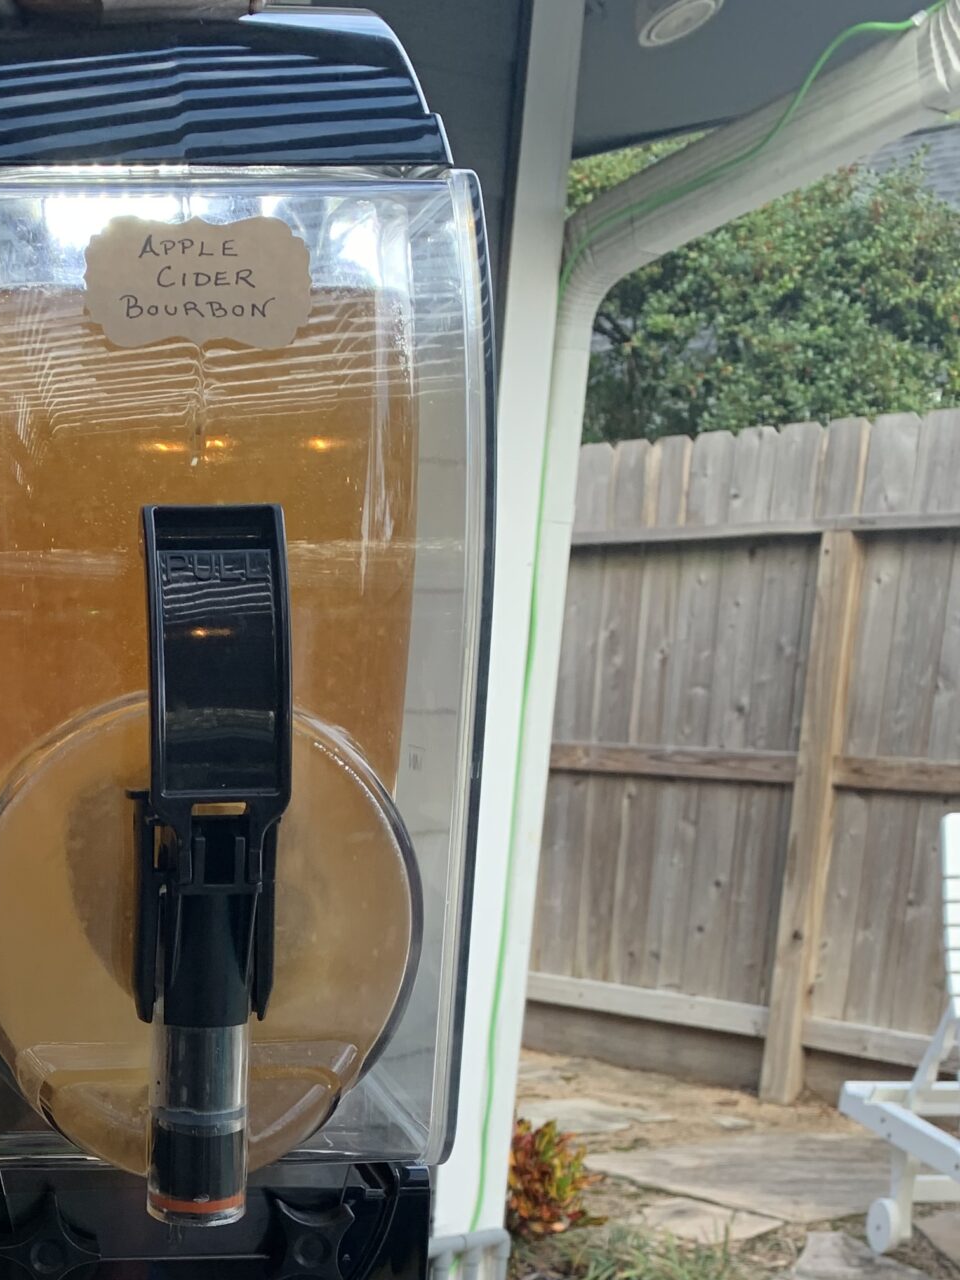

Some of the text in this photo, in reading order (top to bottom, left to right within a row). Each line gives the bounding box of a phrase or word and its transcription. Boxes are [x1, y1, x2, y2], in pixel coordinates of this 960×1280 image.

[138, 233, 238, 258] APPLE
[156, 265, 256, 288] CIDER
[119, 294, 276, 319] BOURBON
[165, 553, 268, 582] PULL
